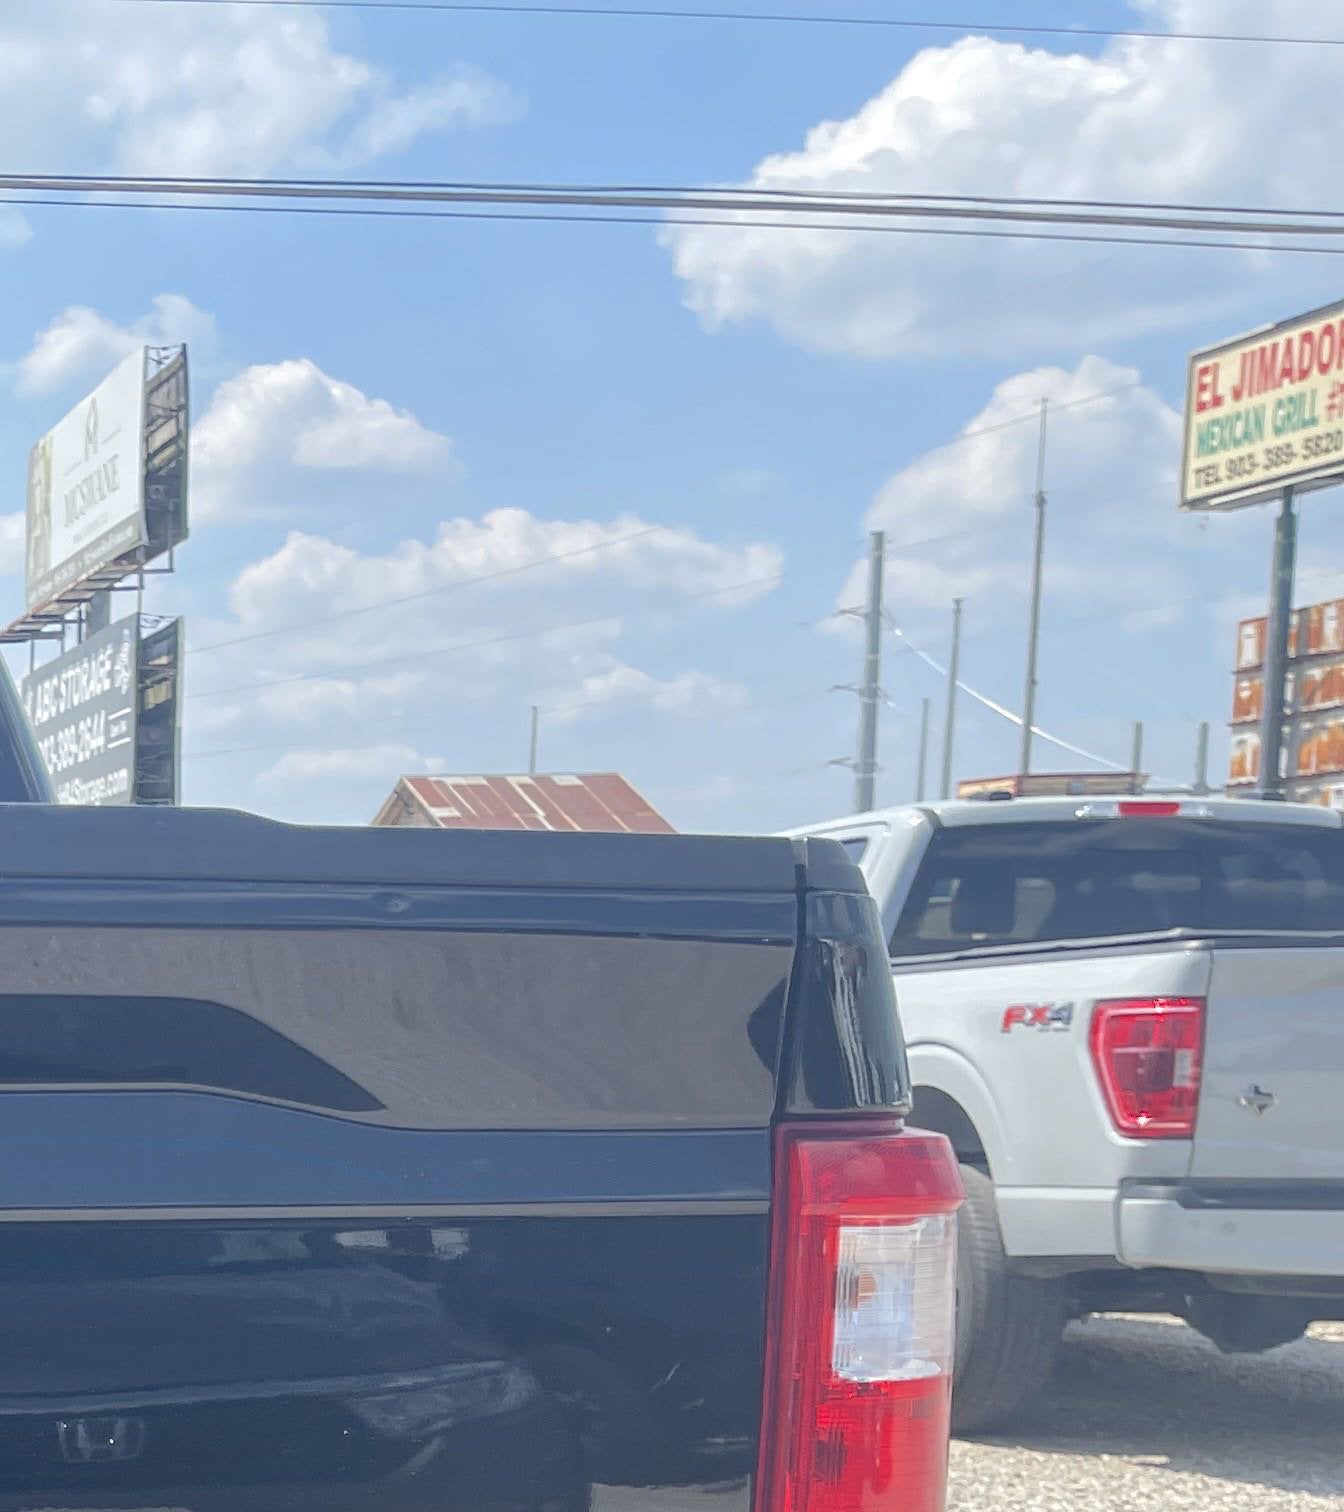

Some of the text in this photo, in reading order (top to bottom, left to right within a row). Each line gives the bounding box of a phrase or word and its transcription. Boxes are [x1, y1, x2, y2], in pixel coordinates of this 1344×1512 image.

[1196, 362, 1224, 412] EL
[1196, 403, 1266, 458] MEXICAN
[1272, 388, 1318, 437] GRILL
[60, 643, 113, 714] STORAGE
[1000, 1002, 1074, 1033] FX4
